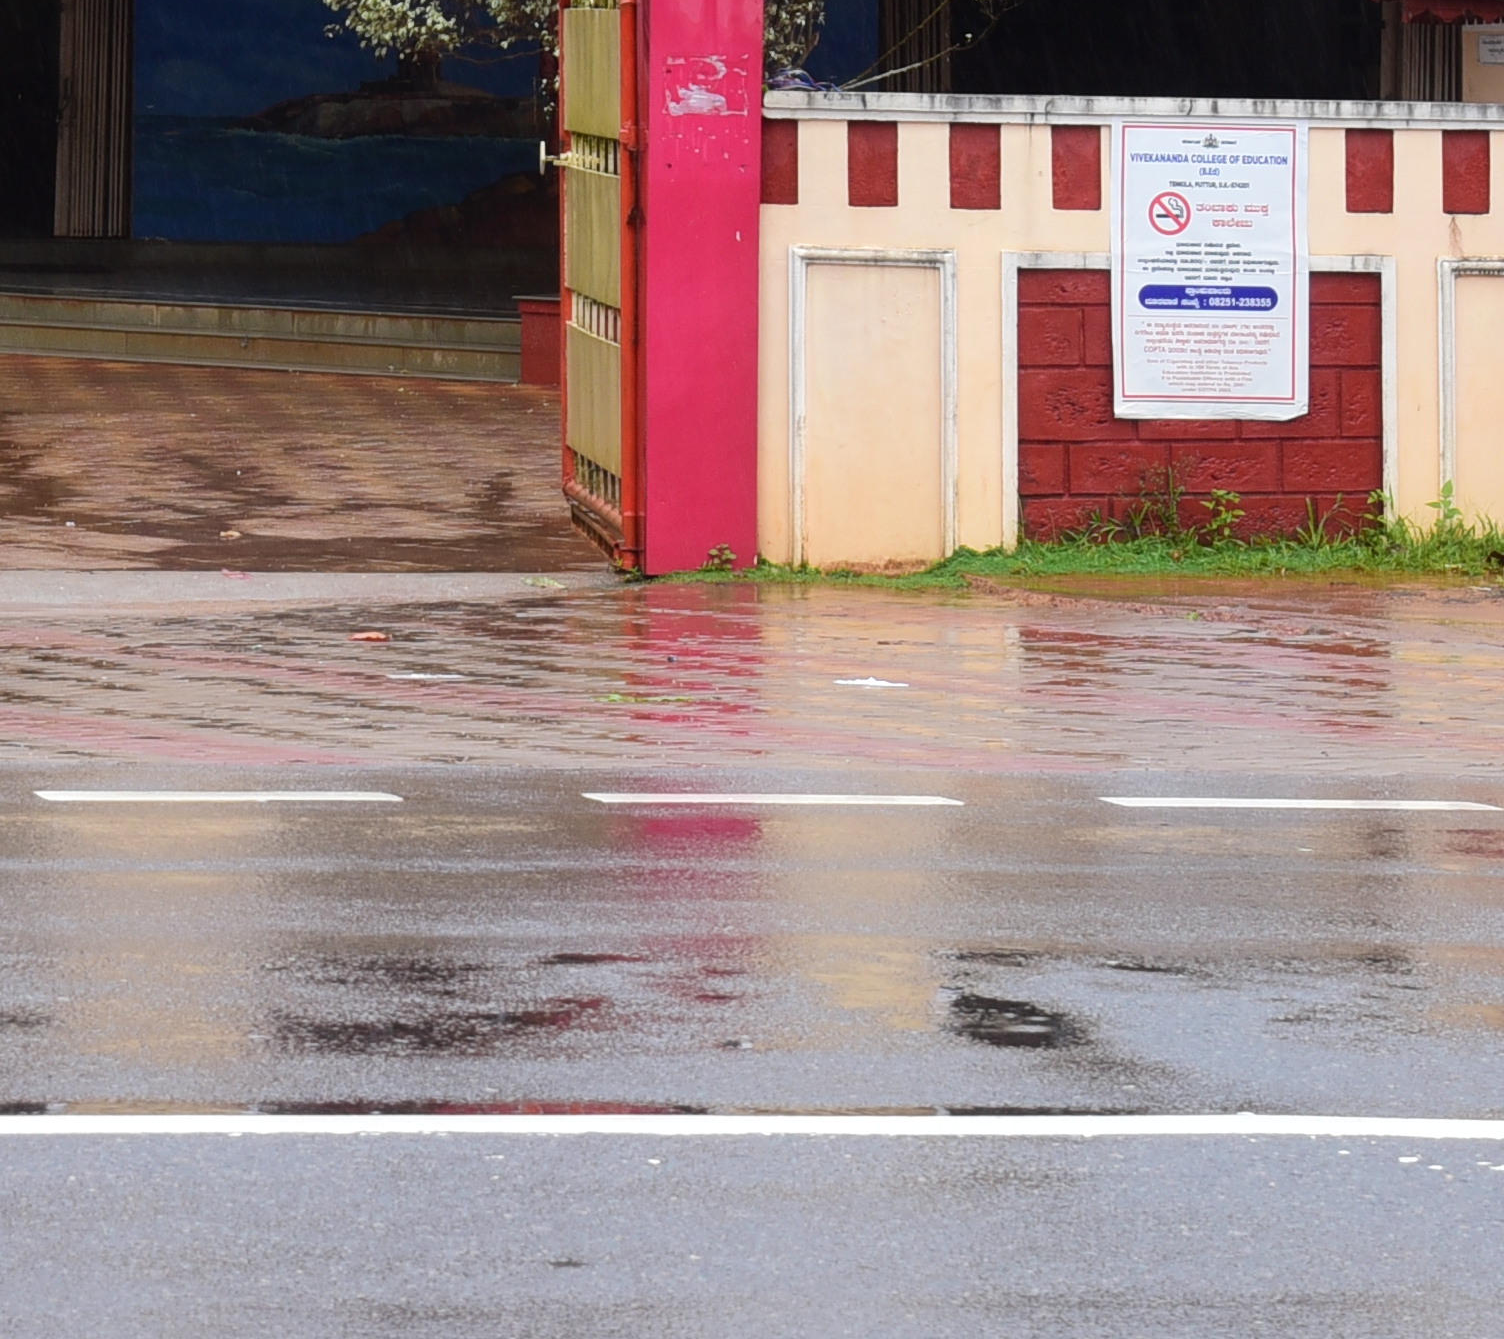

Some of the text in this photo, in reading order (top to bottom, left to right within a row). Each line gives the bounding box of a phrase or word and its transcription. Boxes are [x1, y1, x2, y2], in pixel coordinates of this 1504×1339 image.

[1130, 153, 1287, 165] VIVEKANANDA COLLEGE OF EDUCATION
